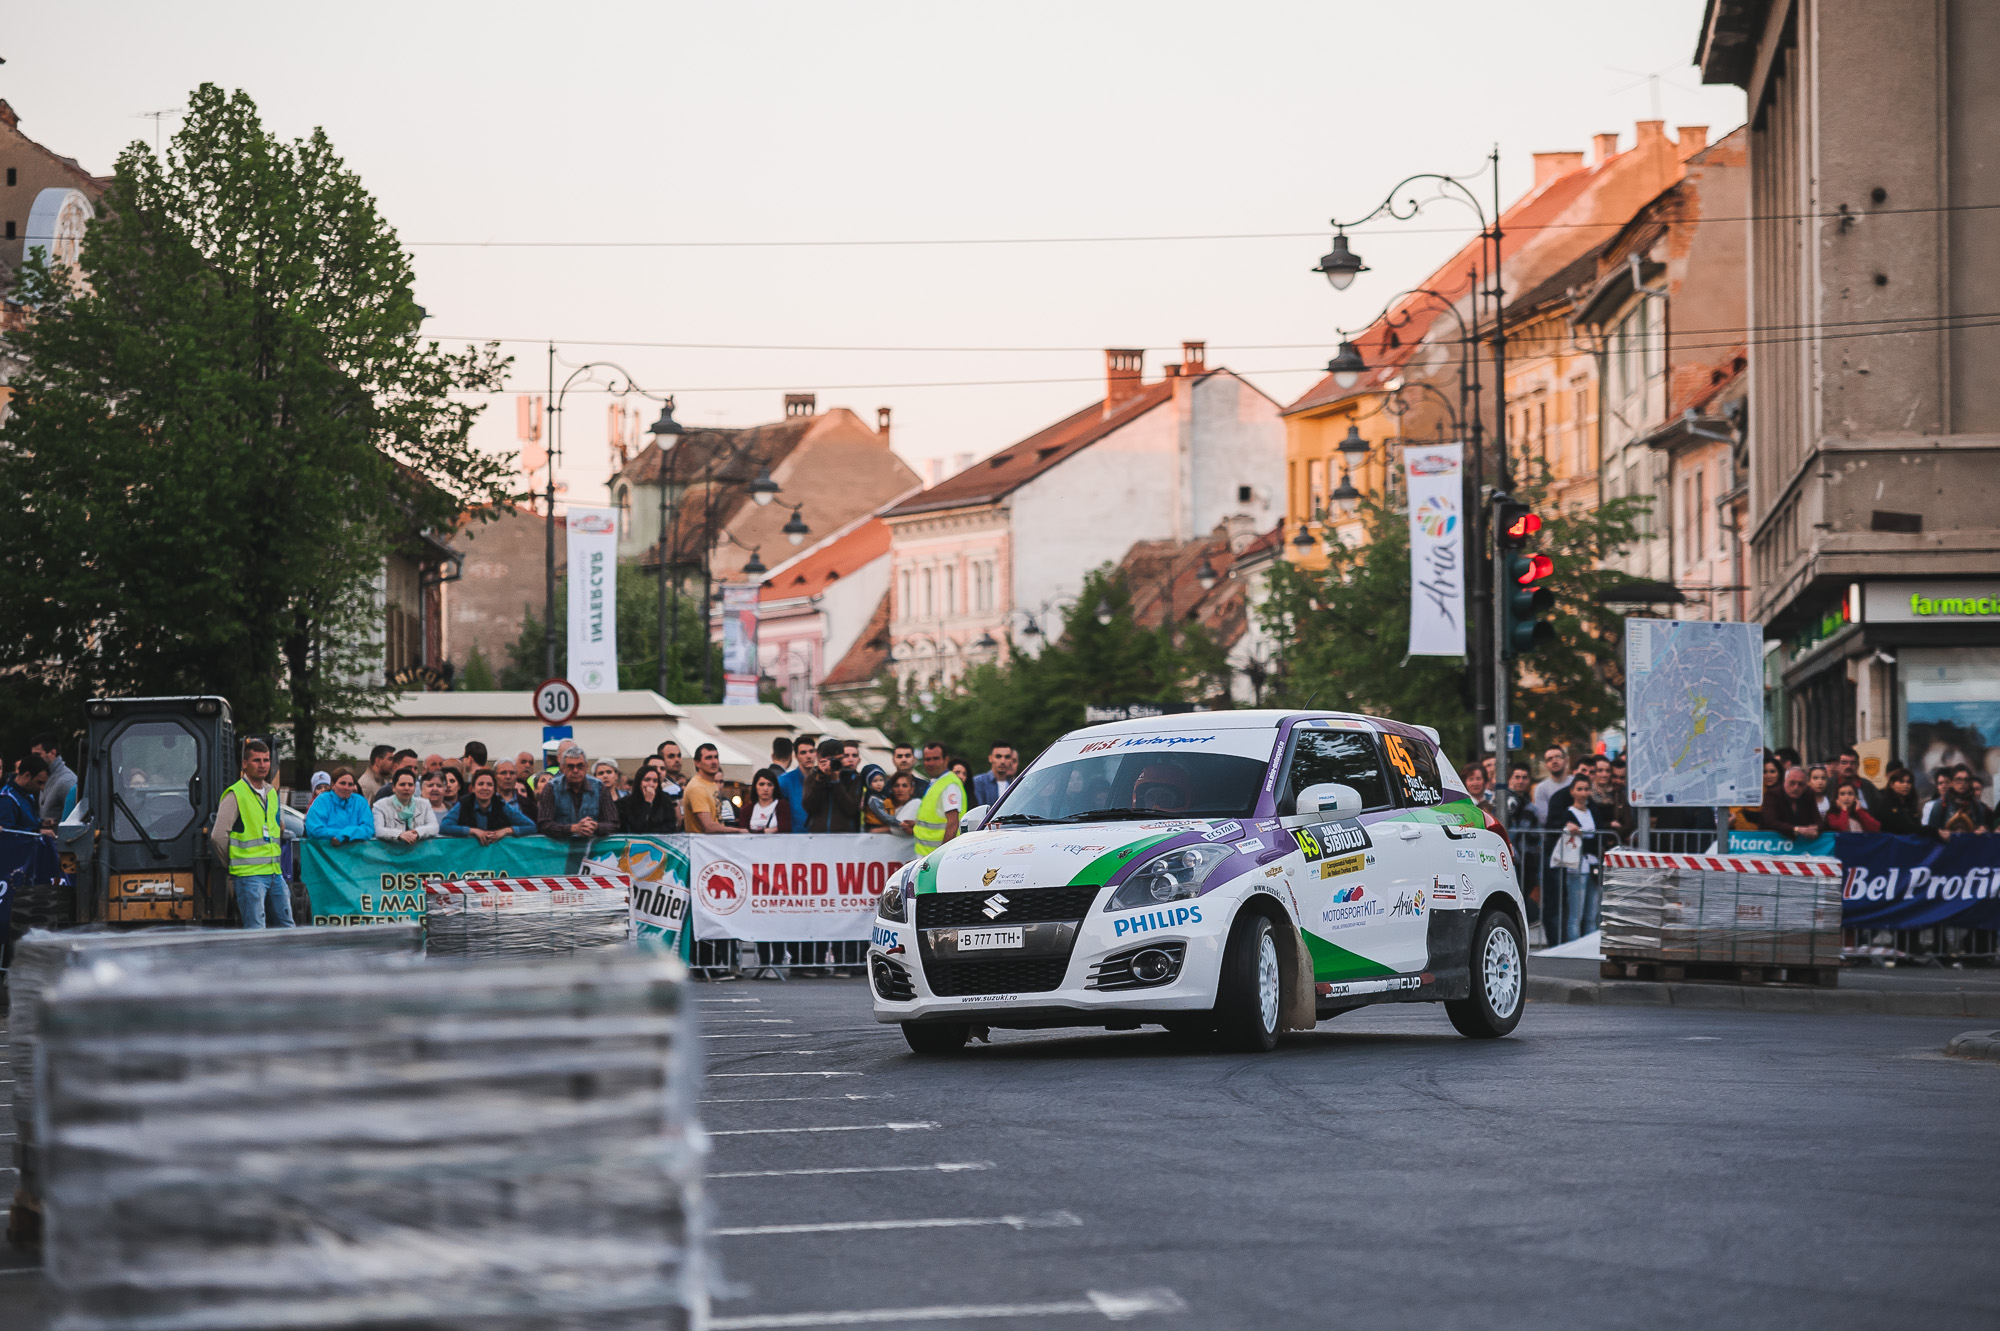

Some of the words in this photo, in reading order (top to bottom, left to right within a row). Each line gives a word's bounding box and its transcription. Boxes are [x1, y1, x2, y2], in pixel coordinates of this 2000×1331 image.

[1419, 538, 1458, 632] Aria
[1910, 592, 2000, 616] farmaci
[544, 690, 569, 713] 30
[1079, 738, 1120, 754] WISE
[1383, 733, 1416, 777] 45
[1436, 813, 1468, 825] SWIFT
[1206, 822, 1236, 840] ECSTAR
[1320, 822, 1345, 837] RALIUL
[1296, 829, 1320, 857] 45
[1323, 829, 1366, 854] SIBIULUI
[1728, 837, 1793, 852] hcare.ro
[751, 862, 828, 896] HARD
[836, 861, 905, 896] WO
[1843, 867, 1900, 901] Bel
[361, 894, 372, 910] E
[379, 894, 425, 911] MAI
[751, 898, 815, 908] COMPANIE
[821, 898, 836, 908] DE
[1389, 891, 1414, 918] Aria
[314, 915, 410, 927] PRIET
[1113, 905, 1203, 937] PHILIPS
[964, 934, 972, 946] B
[974, 933, 992, 945] 777
[994, 932, 1016, 944] TTH
[1400, 976, 1421, 991] CUP
[962, 995, 1018, 1003] www.suzuki.ro
